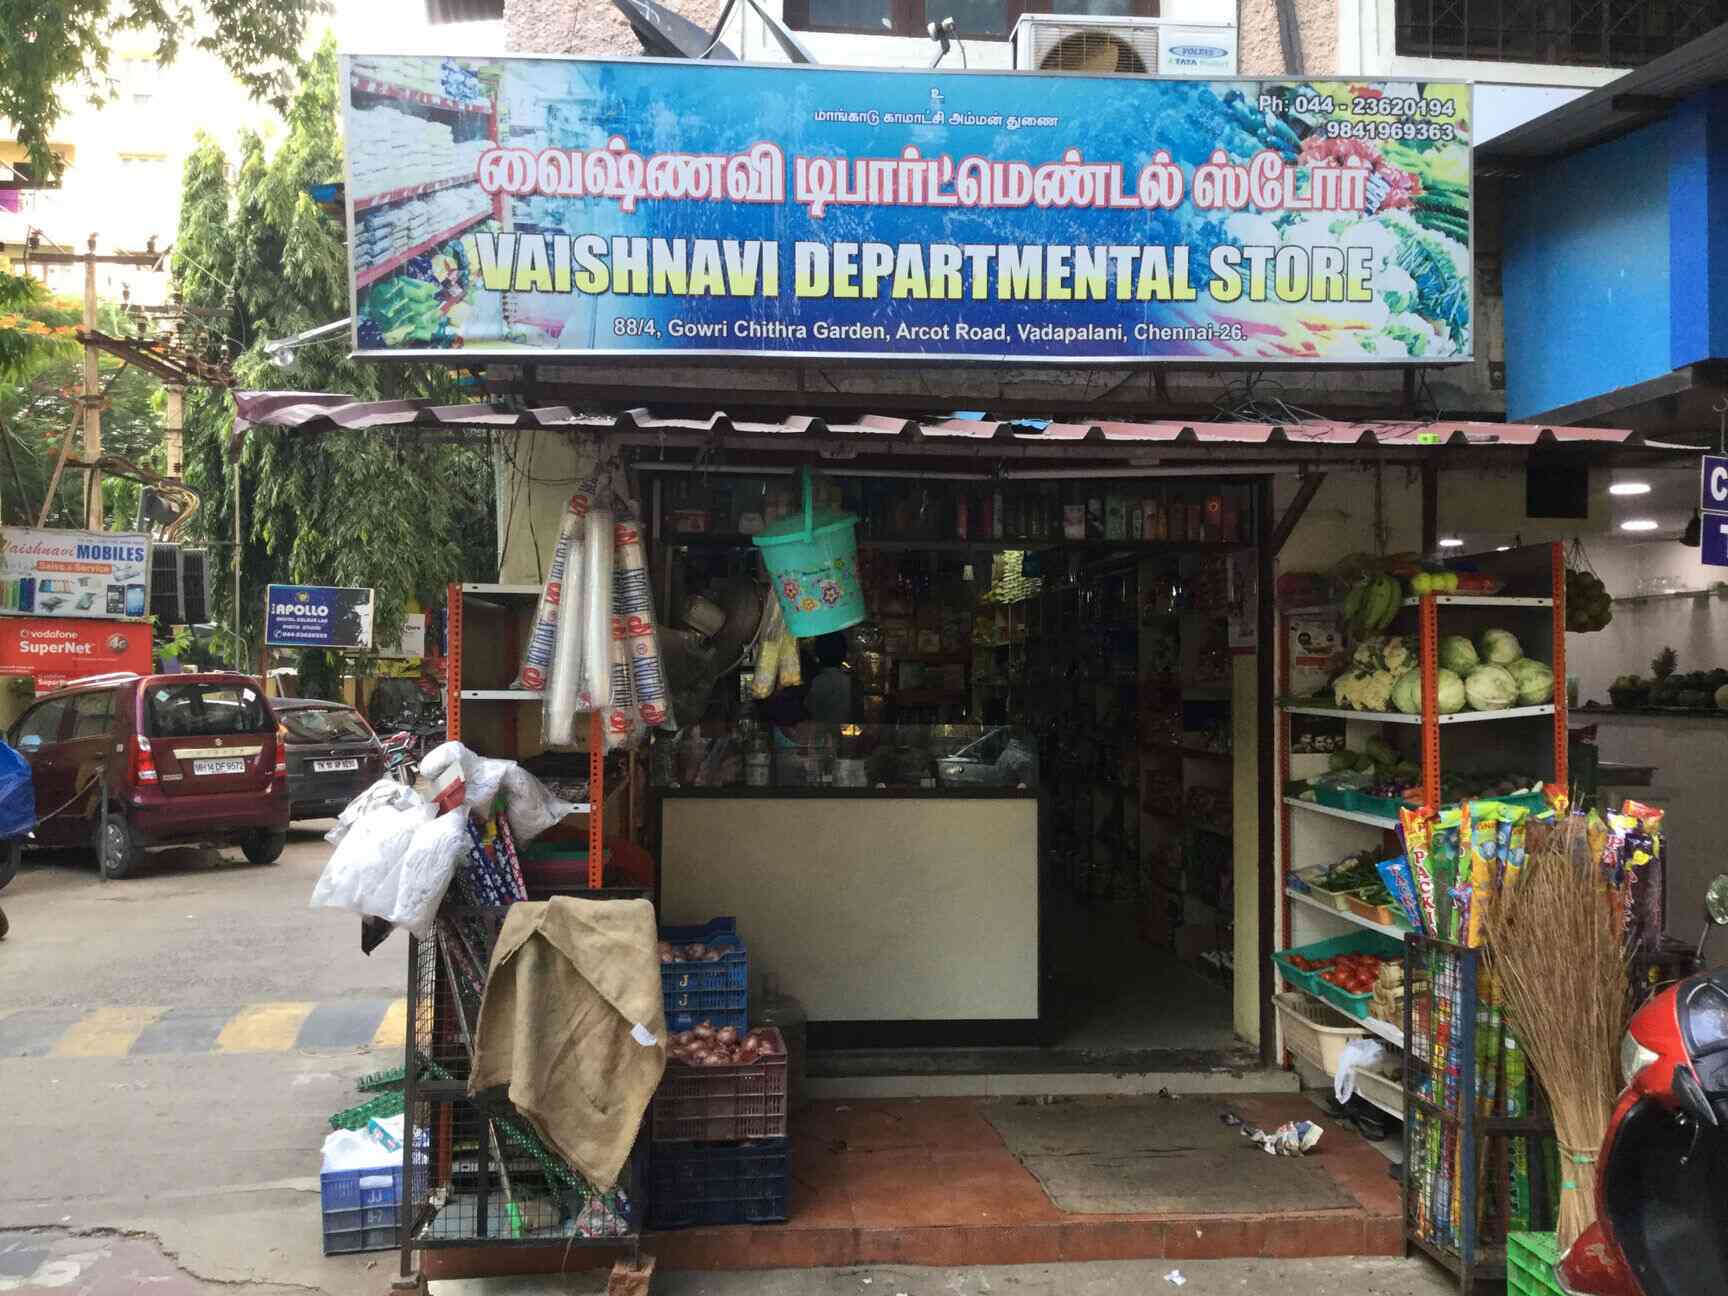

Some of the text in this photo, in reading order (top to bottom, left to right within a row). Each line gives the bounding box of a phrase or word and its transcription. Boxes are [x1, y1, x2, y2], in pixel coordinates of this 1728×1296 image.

[1259, 95, 1289, 113] Ph:
[1295, 97, 1333, 113] 044
[1353, 98, 1455, 117] 23620194
[814, 108, 1059, 130] மாங்காடு காமாட்சி அம்மன் துணை
[1327, 121, 1455, 141] 9841969363
[478, 135, 1370, 219] வைஷ்ணவி டிபார்ட்மெண்டல் ஸ்டோர்
[474, 231, 1374, 302] VAISHNAVI DEPARTMENTAL STORE
[613, 319, 1249, 344] 88/4, Gowri Chithra Garden, Arcot Road, Vadapalani, Chennai-26.
[76, 543, 145, 562] MOBILES
[276, 603, 329, 617] APOLLO
[31, 629, 79, 640] vodafone
[19, 640, 92, 656] SuperNet
